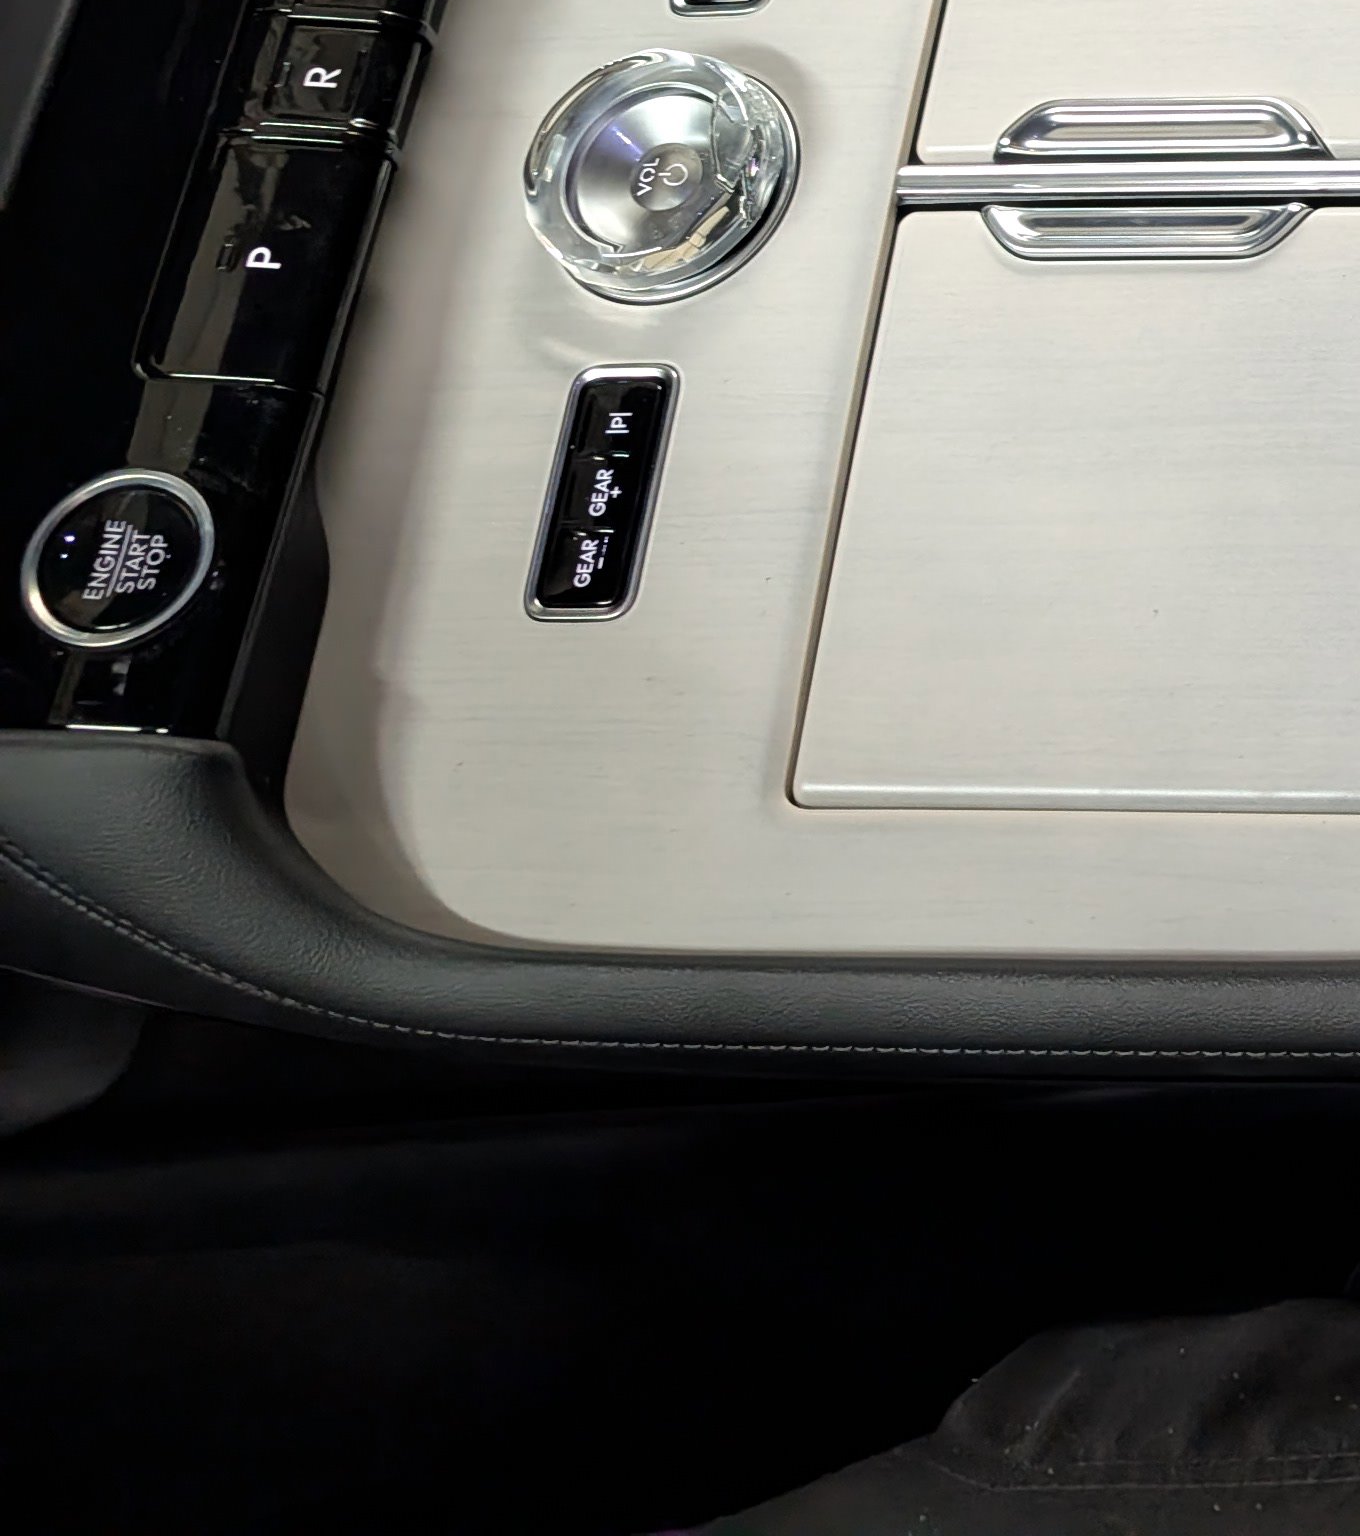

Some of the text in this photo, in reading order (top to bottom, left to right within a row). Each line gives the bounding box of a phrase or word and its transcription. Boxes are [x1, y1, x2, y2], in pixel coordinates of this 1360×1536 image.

[304, 67, 343, 89] R
[636, 157, 660, 196] VOL
[246, 246, 281, 270] P
[588, 468, 615, 517] GEAR
[81, 519, 127, 600] ENGINE
[114, 529, 151, 594] START
[136, 534, 169, 591] STOP
[573, 538, 600, 588] GEAR
